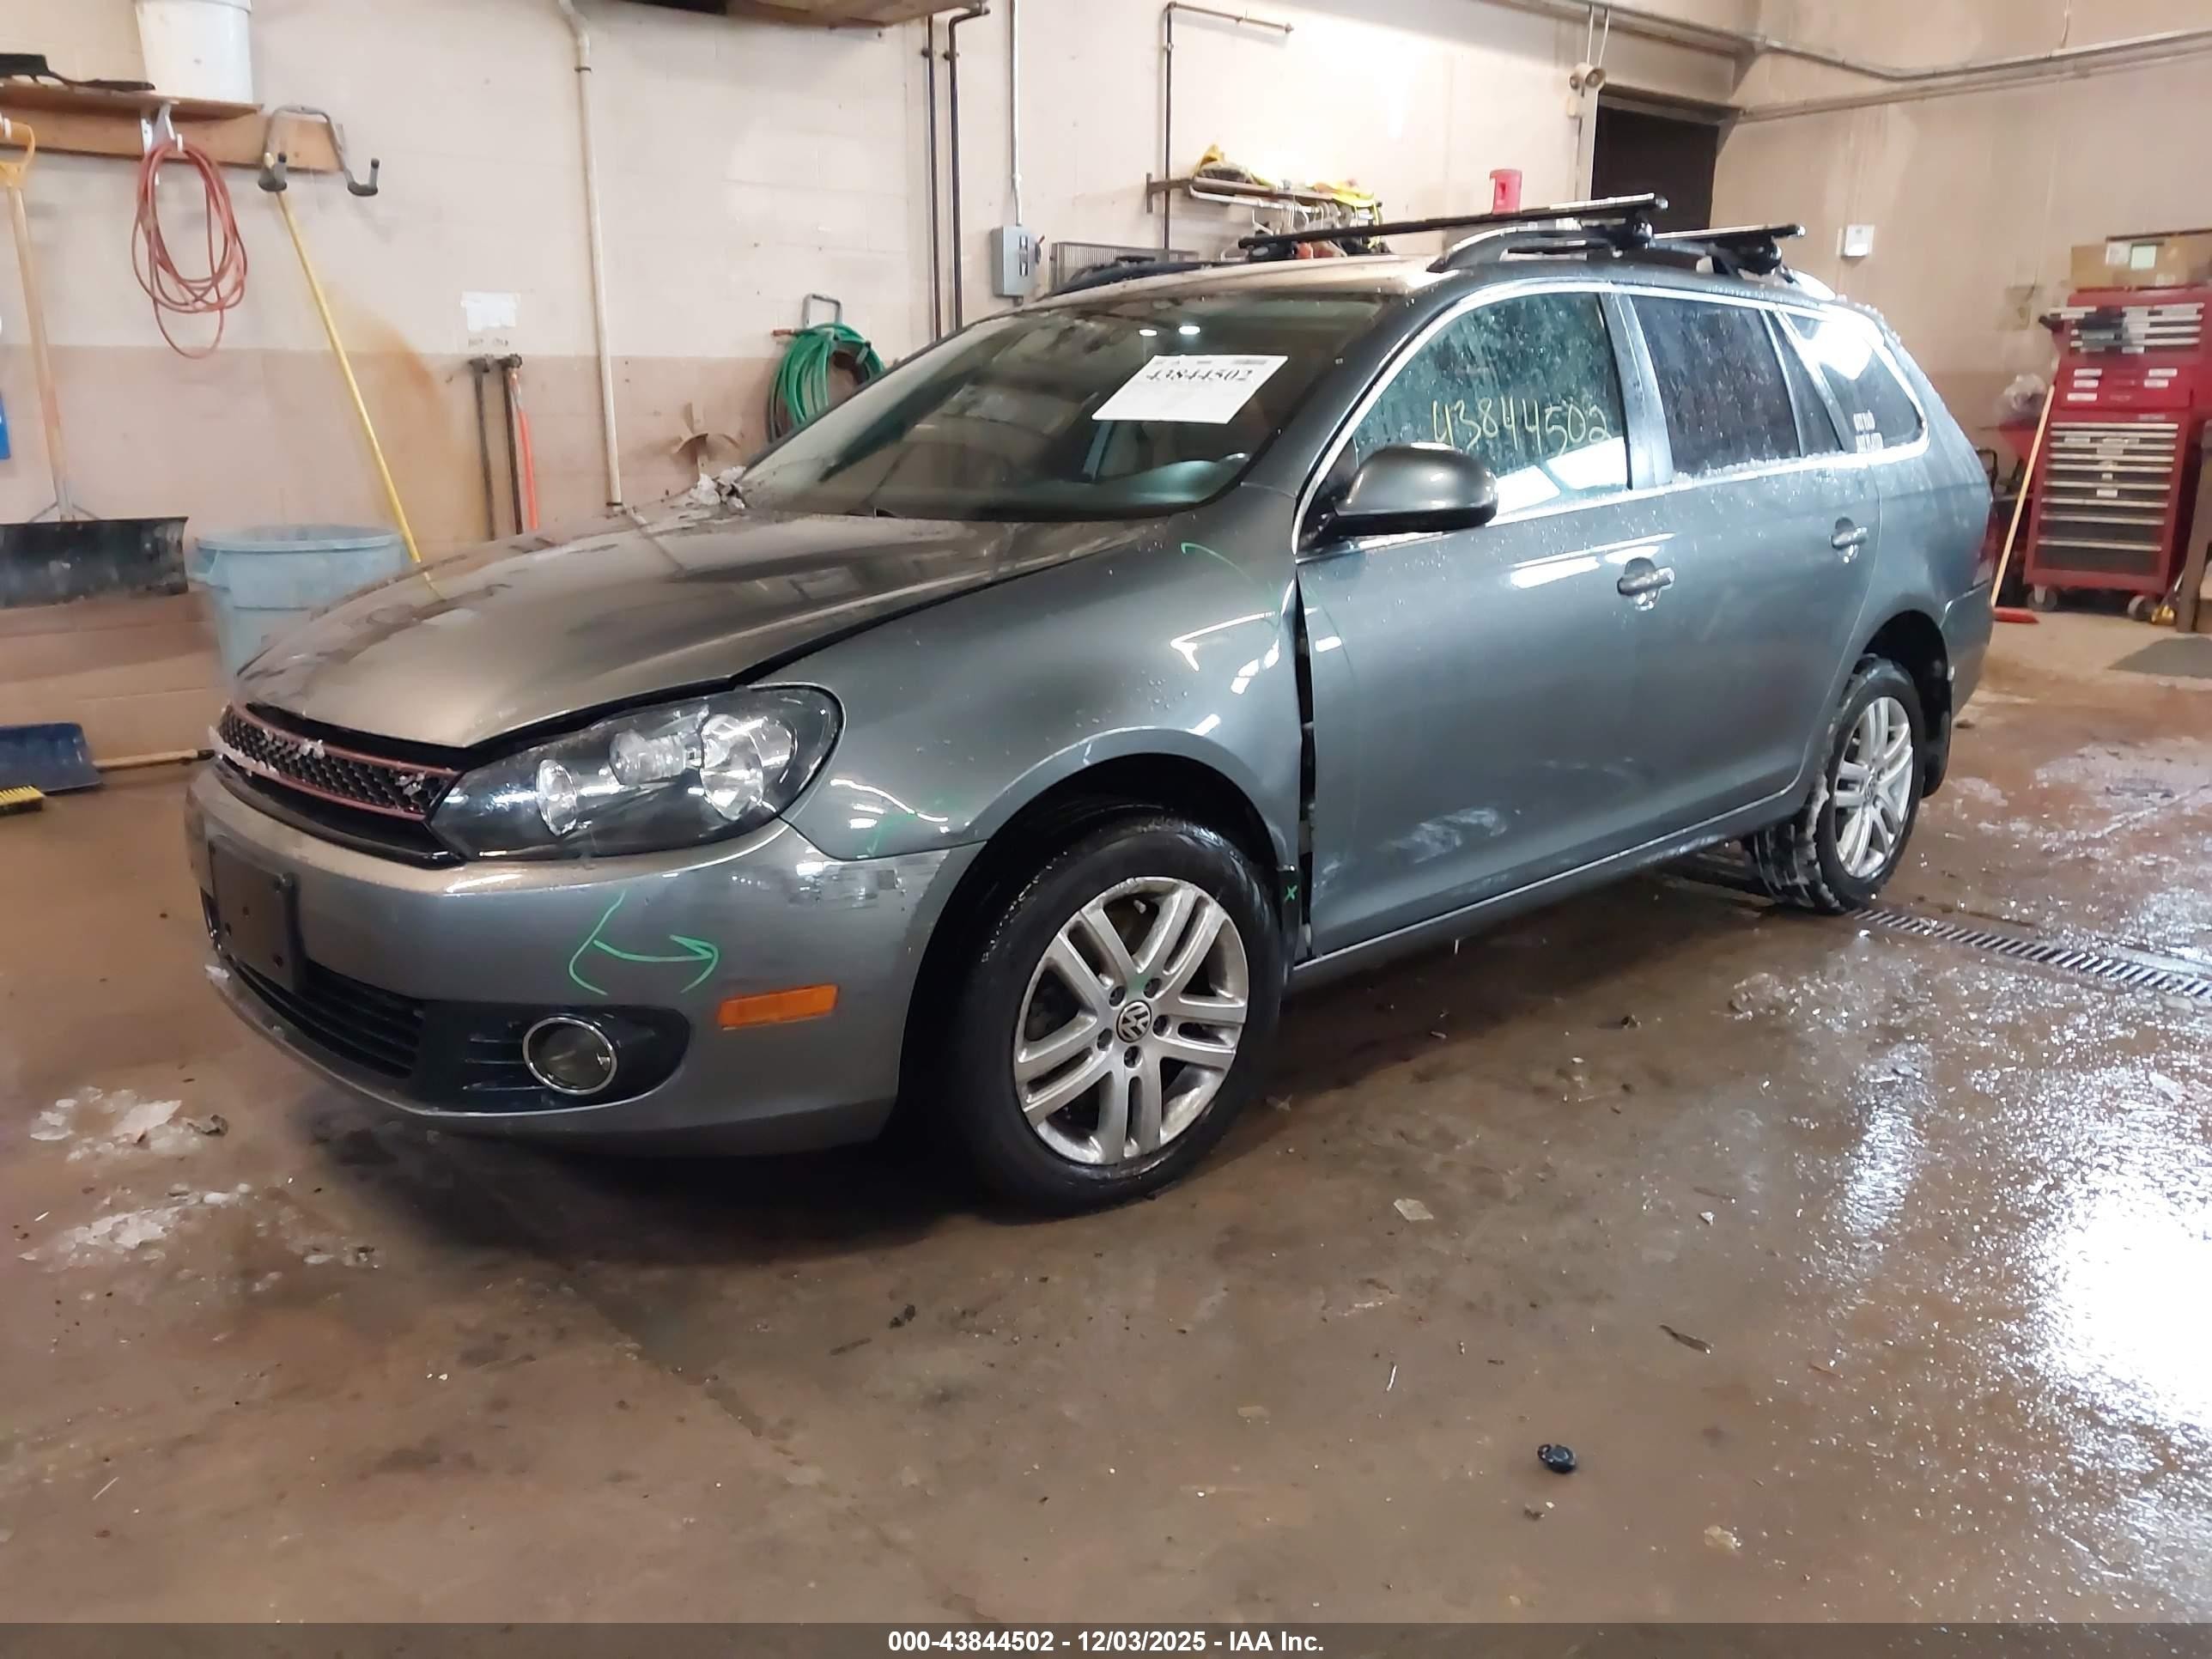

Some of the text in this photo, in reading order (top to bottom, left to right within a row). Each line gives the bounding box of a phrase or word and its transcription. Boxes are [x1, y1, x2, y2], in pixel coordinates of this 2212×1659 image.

[1146, 368, 1253, 381] 43844502
[1432, 394, 1613, 456] 43844502
[1117, 1001, 1152, 1042] VW
